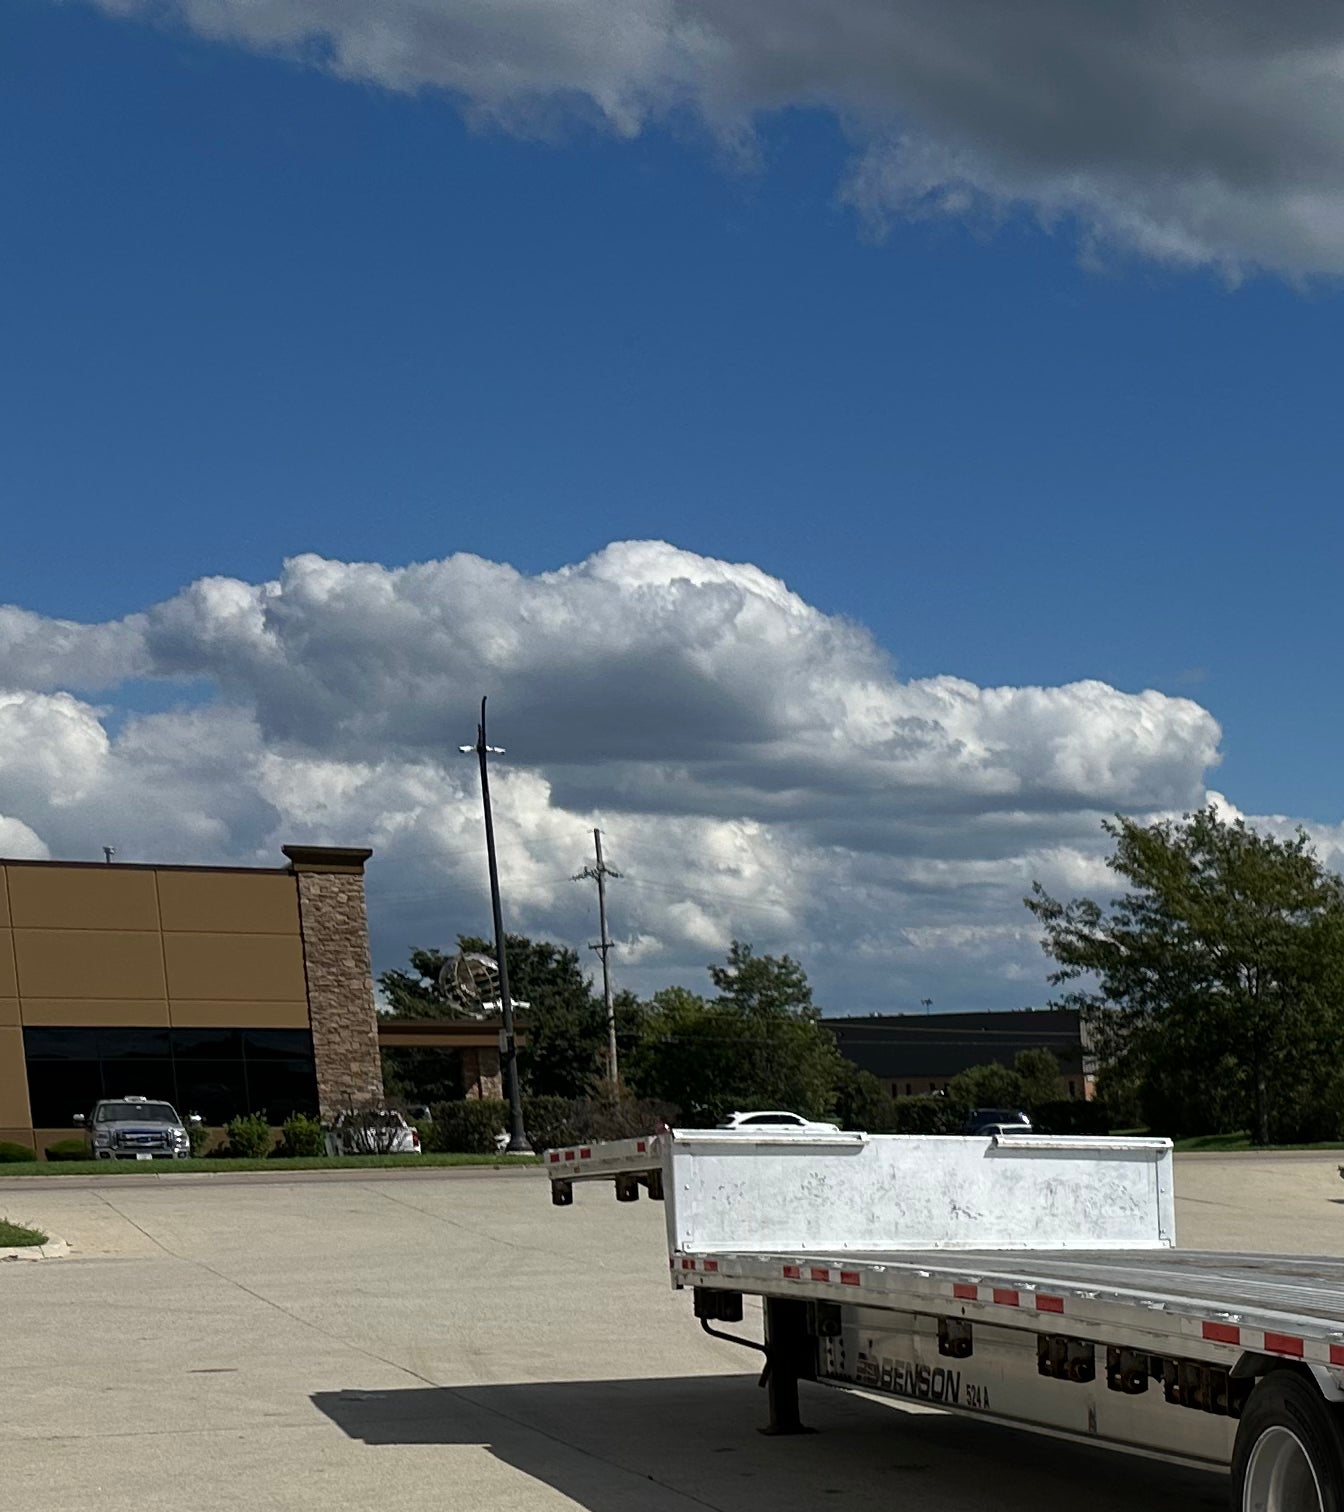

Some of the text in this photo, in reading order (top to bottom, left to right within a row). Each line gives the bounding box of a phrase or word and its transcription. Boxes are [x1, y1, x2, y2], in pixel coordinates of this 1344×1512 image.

[880, 1357, 991, 1409] BENSON 524 A
